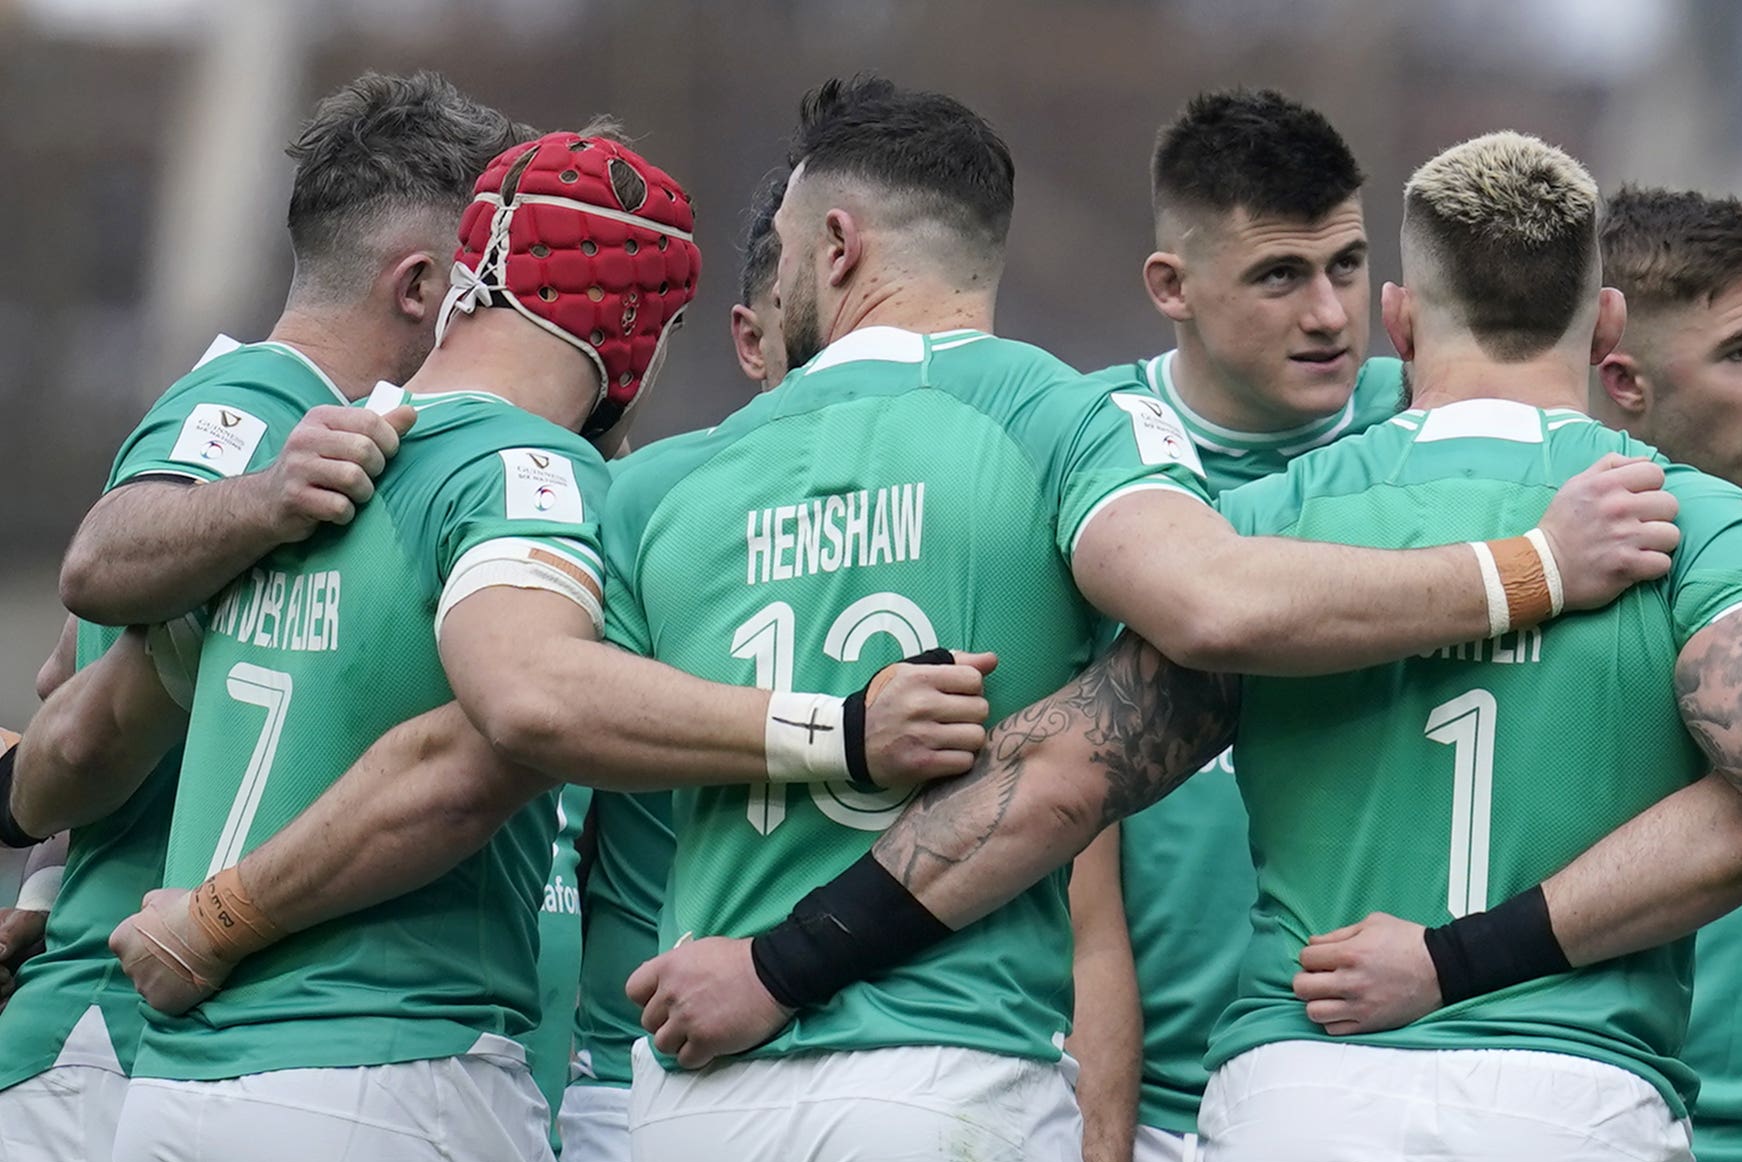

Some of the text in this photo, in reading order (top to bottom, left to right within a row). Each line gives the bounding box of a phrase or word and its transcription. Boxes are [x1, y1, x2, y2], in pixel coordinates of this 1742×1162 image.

[746, 482, 925, 585] HENSHAW
[204, 660, 293, 882] 7
[1424, 688, 1498, 919] 1
